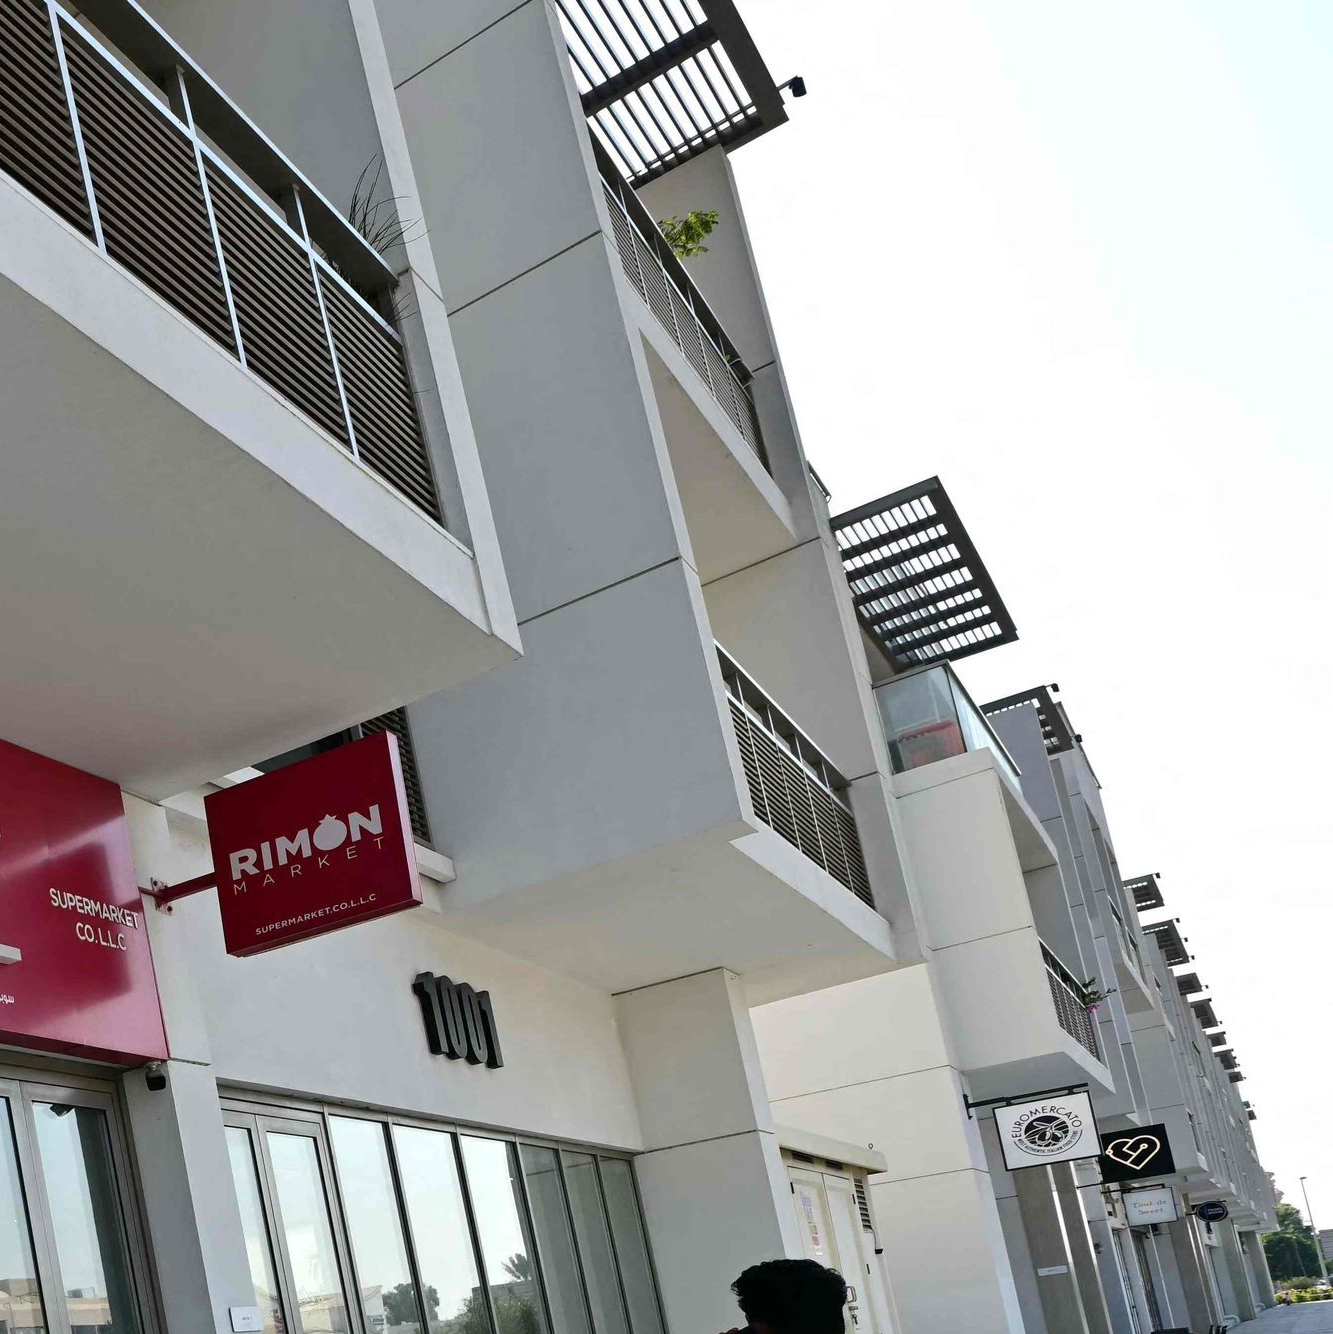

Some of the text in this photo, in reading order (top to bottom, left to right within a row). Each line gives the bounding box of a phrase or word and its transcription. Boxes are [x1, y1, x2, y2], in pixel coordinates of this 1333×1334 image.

[229, 803, 383, 881] RIMON
[233, 836, 384, 895] MARKET
[49, 887, 138, 929] SUPERMARKET
[1011, 1105, 1082, 1139] EUROMERCATO
